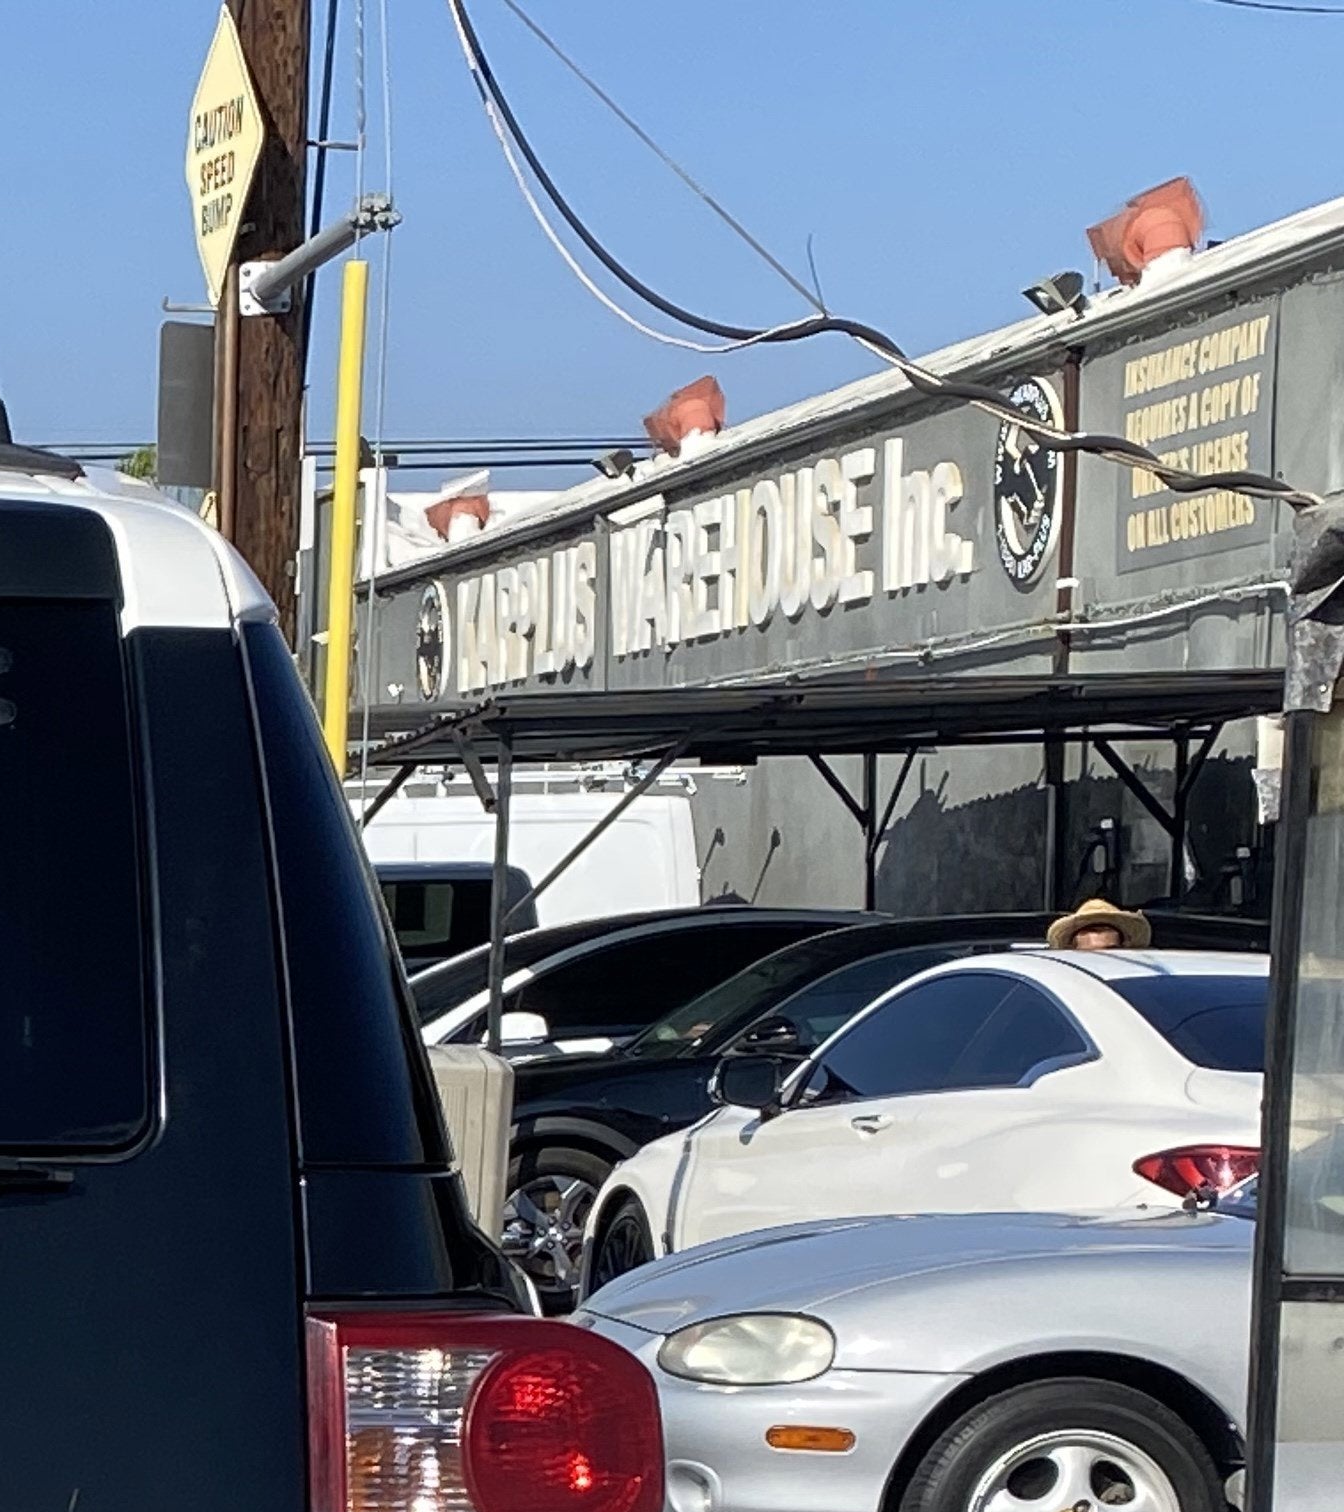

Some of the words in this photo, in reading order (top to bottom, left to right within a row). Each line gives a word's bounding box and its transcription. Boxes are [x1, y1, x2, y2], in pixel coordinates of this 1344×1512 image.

[194, 94, 245, 154] CAUTION
[199, 151, 236, 196] SPEED
[201, 193, 233, 237] BUMP
[1124, 339, 1200, 399] INSURANCE
[1198, 315, 1270, 375] COMPANY
[1125, 395, 1188, 447] REQUIRES
[1188, 391, 1198, 430] A
[1200, 378, 1240, 427] COPY
[1240, 372, 1261, 416] OF
[1192, 431, 1249, 476] LICENSE
[1127, 511, 1146, 552] ON
[1146, 506, 1170, 547] ALL
[1170, 490, 1255, 541] CUSTOMERS
[457, 541, 597, 693] KARPLUS
[611, 447, 876, 657] WAREHOUSE
[883, 437, 975, 593] Inc.
